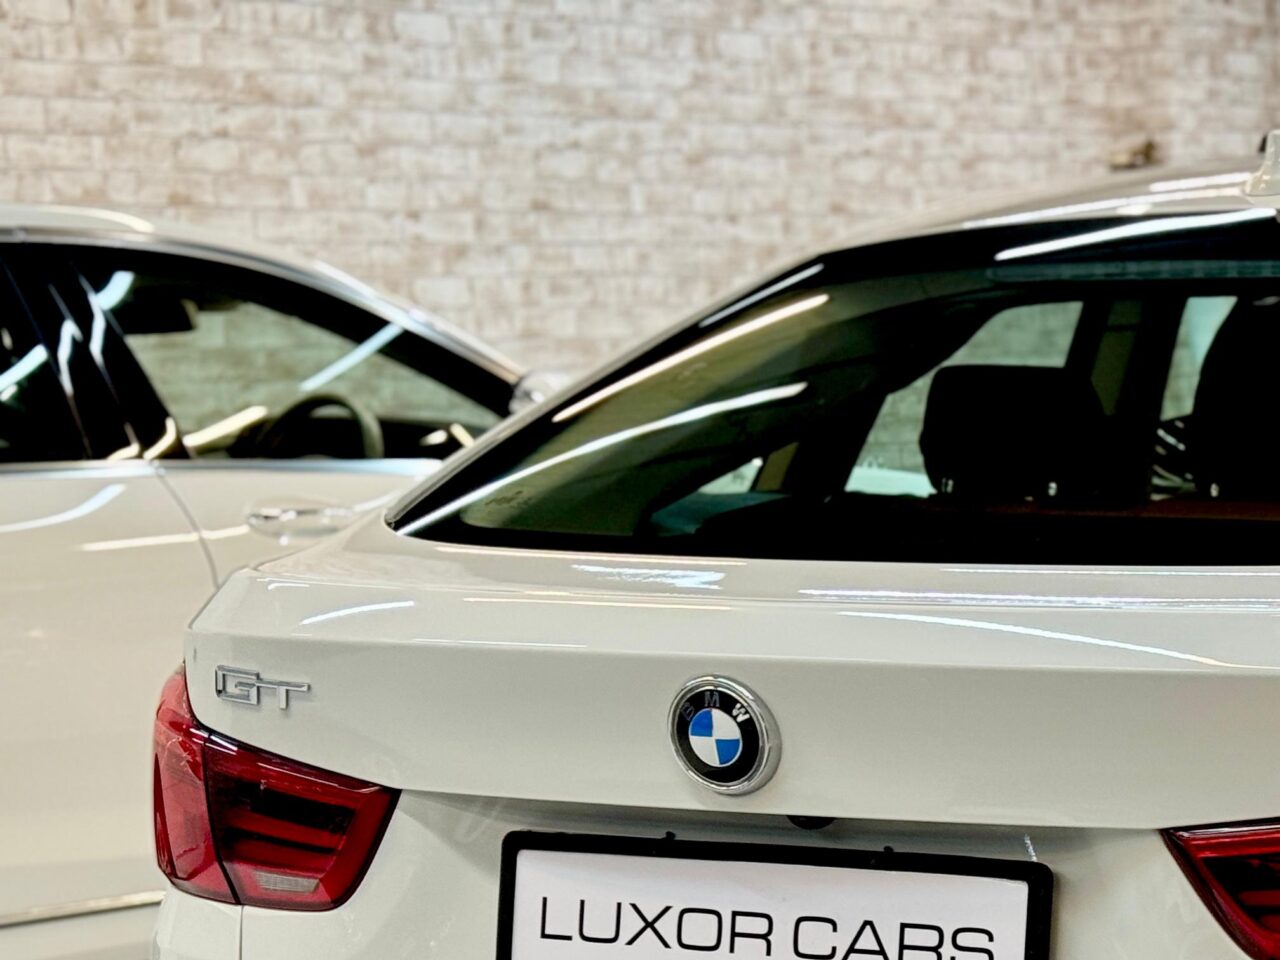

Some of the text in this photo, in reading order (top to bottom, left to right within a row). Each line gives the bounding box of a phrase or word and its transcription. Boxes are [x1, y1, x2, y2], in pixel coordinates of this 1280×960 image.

[215, 665, 310, 710] GT
[681, 691, 750, 722] BMW
[539, 896, 774, 957] LUXOR
